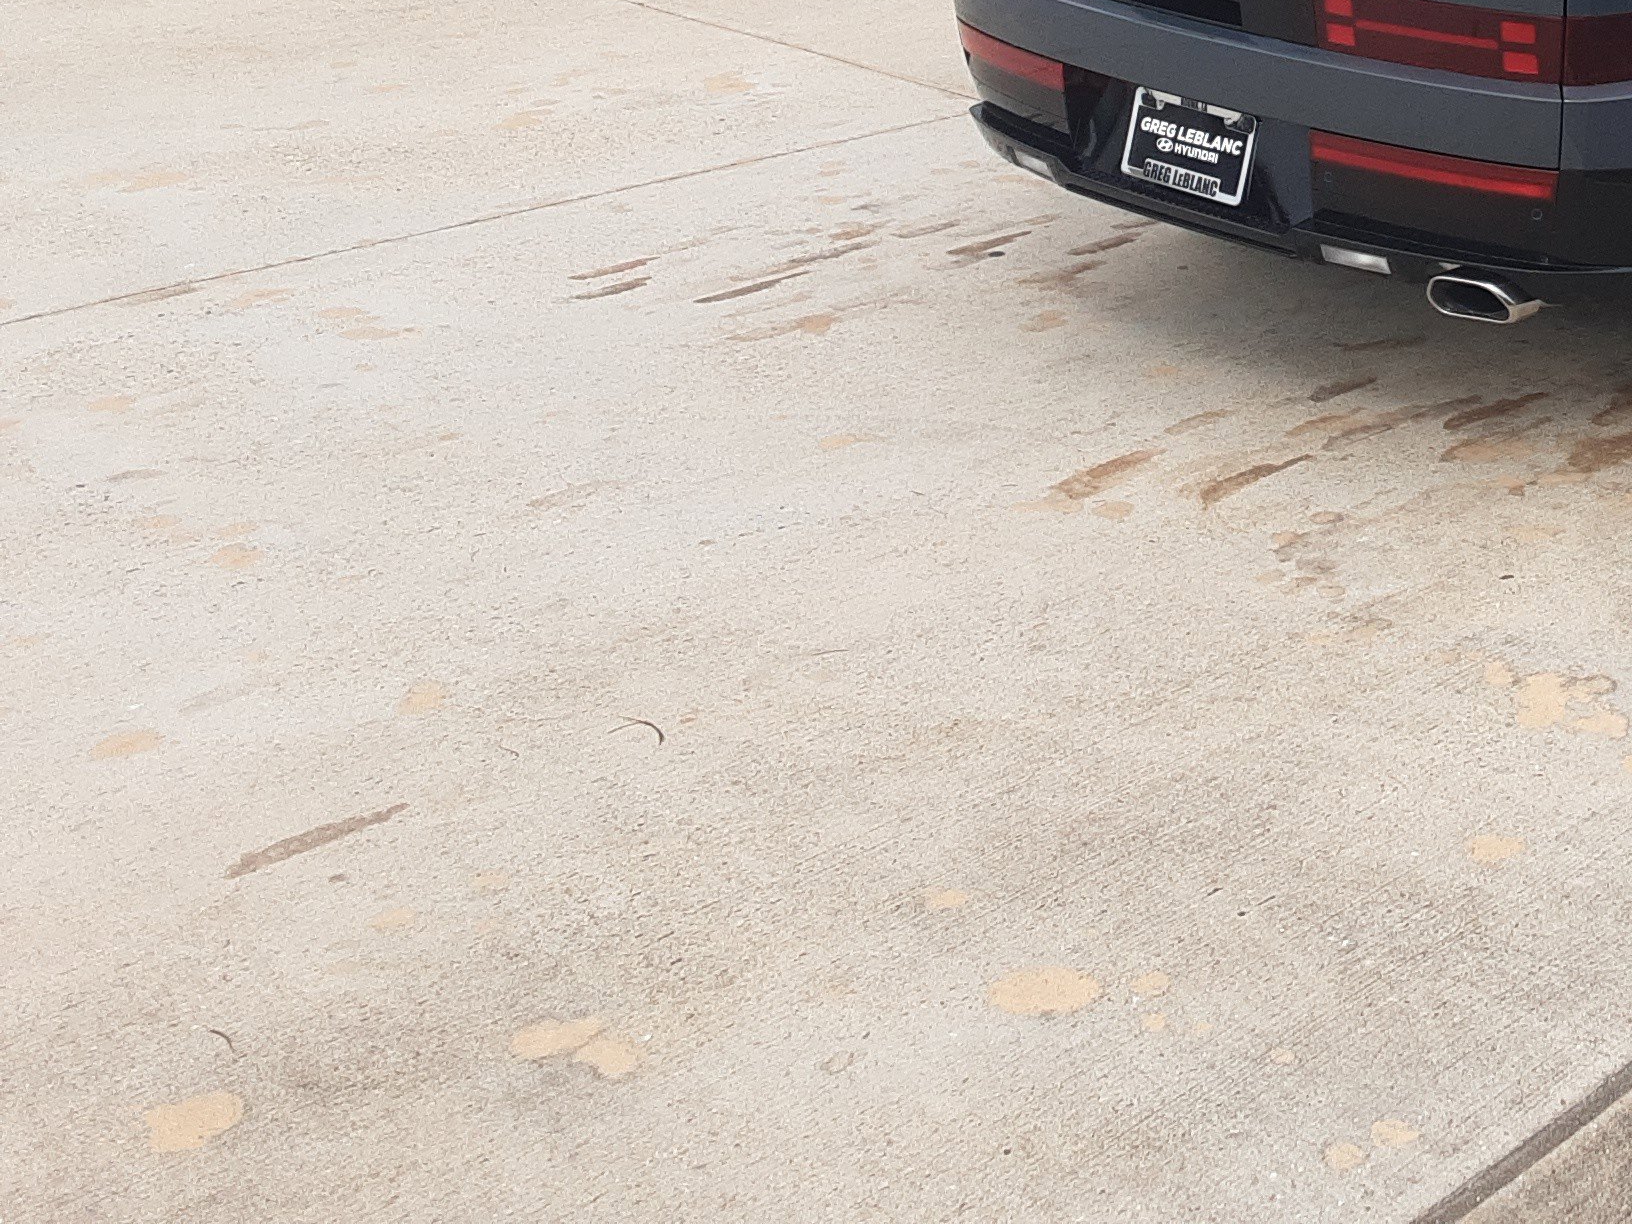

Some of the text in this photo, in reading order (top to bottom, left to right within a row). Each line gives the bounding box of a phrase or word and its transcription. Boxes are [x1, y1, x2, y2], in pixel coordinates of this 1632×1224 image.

[1140, 116, 1243, 156] GREG LEBLANC
[1174, 142, 1219, 164] HYUNDAI
[1142, 160, 1172, 183] GREG
